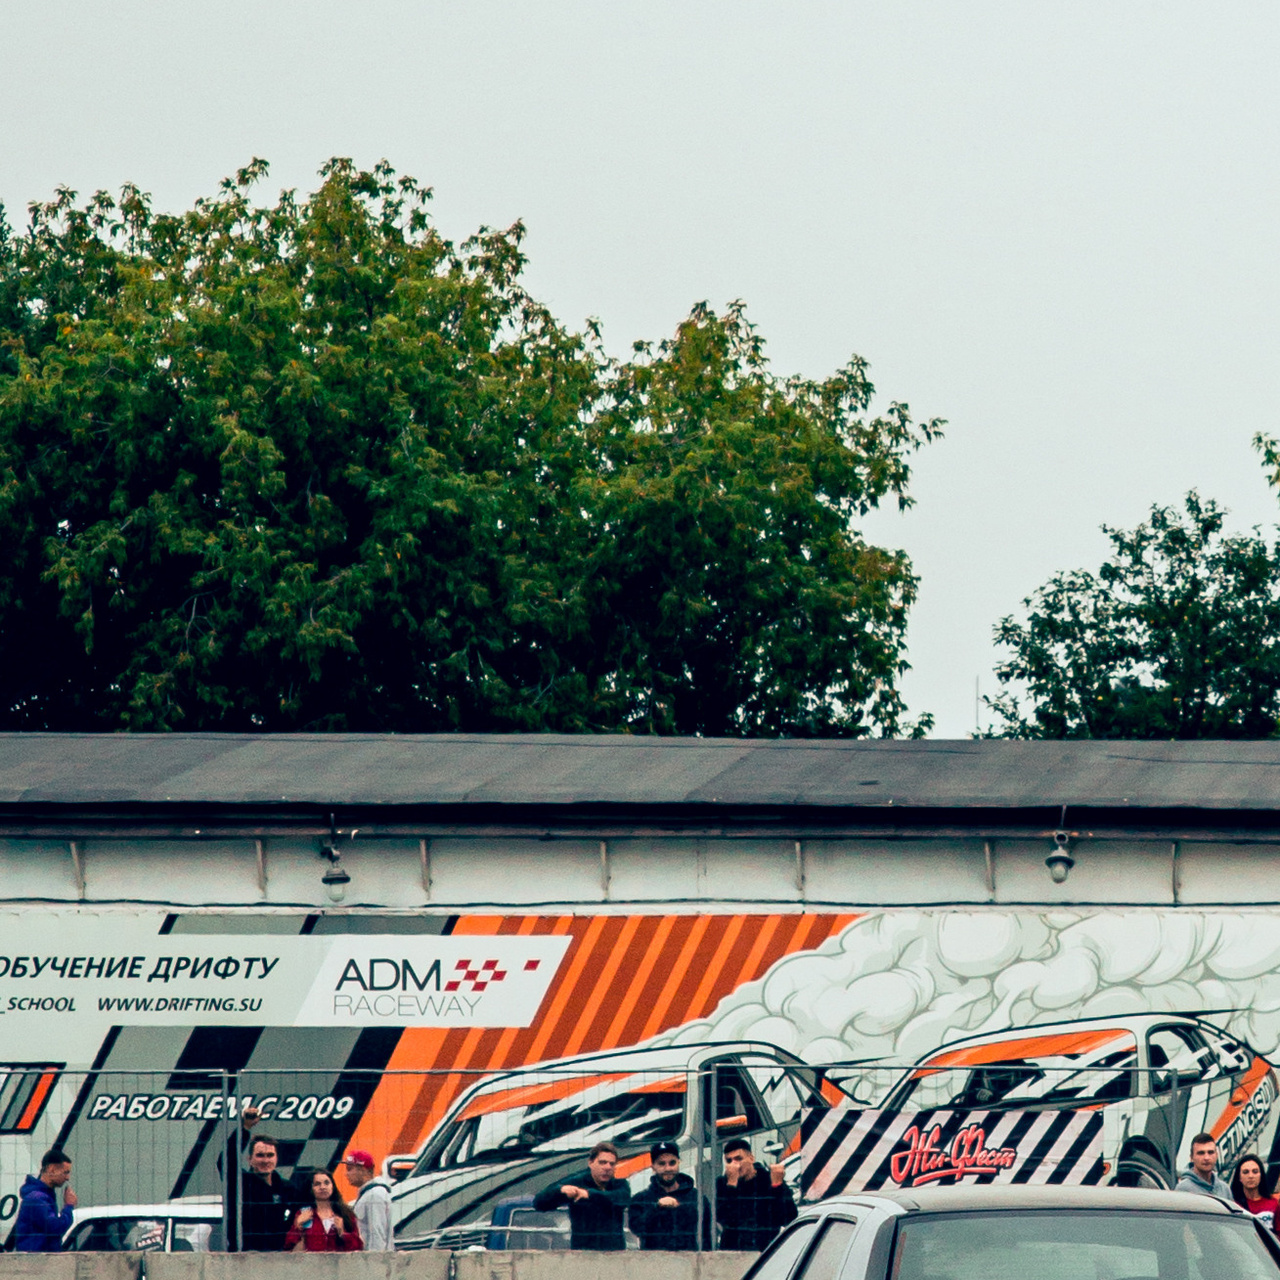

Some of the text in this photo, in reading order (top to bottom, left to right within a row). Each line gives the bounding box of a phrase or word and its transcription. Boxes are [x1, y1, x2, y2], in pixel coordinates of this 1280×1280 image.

[147, 956, 280, 983] ДРИФТУ
[335, 958, 441, 992] ADM
[98, 998, 263, 1012] WWW.DRIFTING.SU
[333, 995, 482, 1017] RACEWAY
[91, 1096, 244, 1119] РАБОТАЕМ
[278, 1095, 355, 1119] 2009
